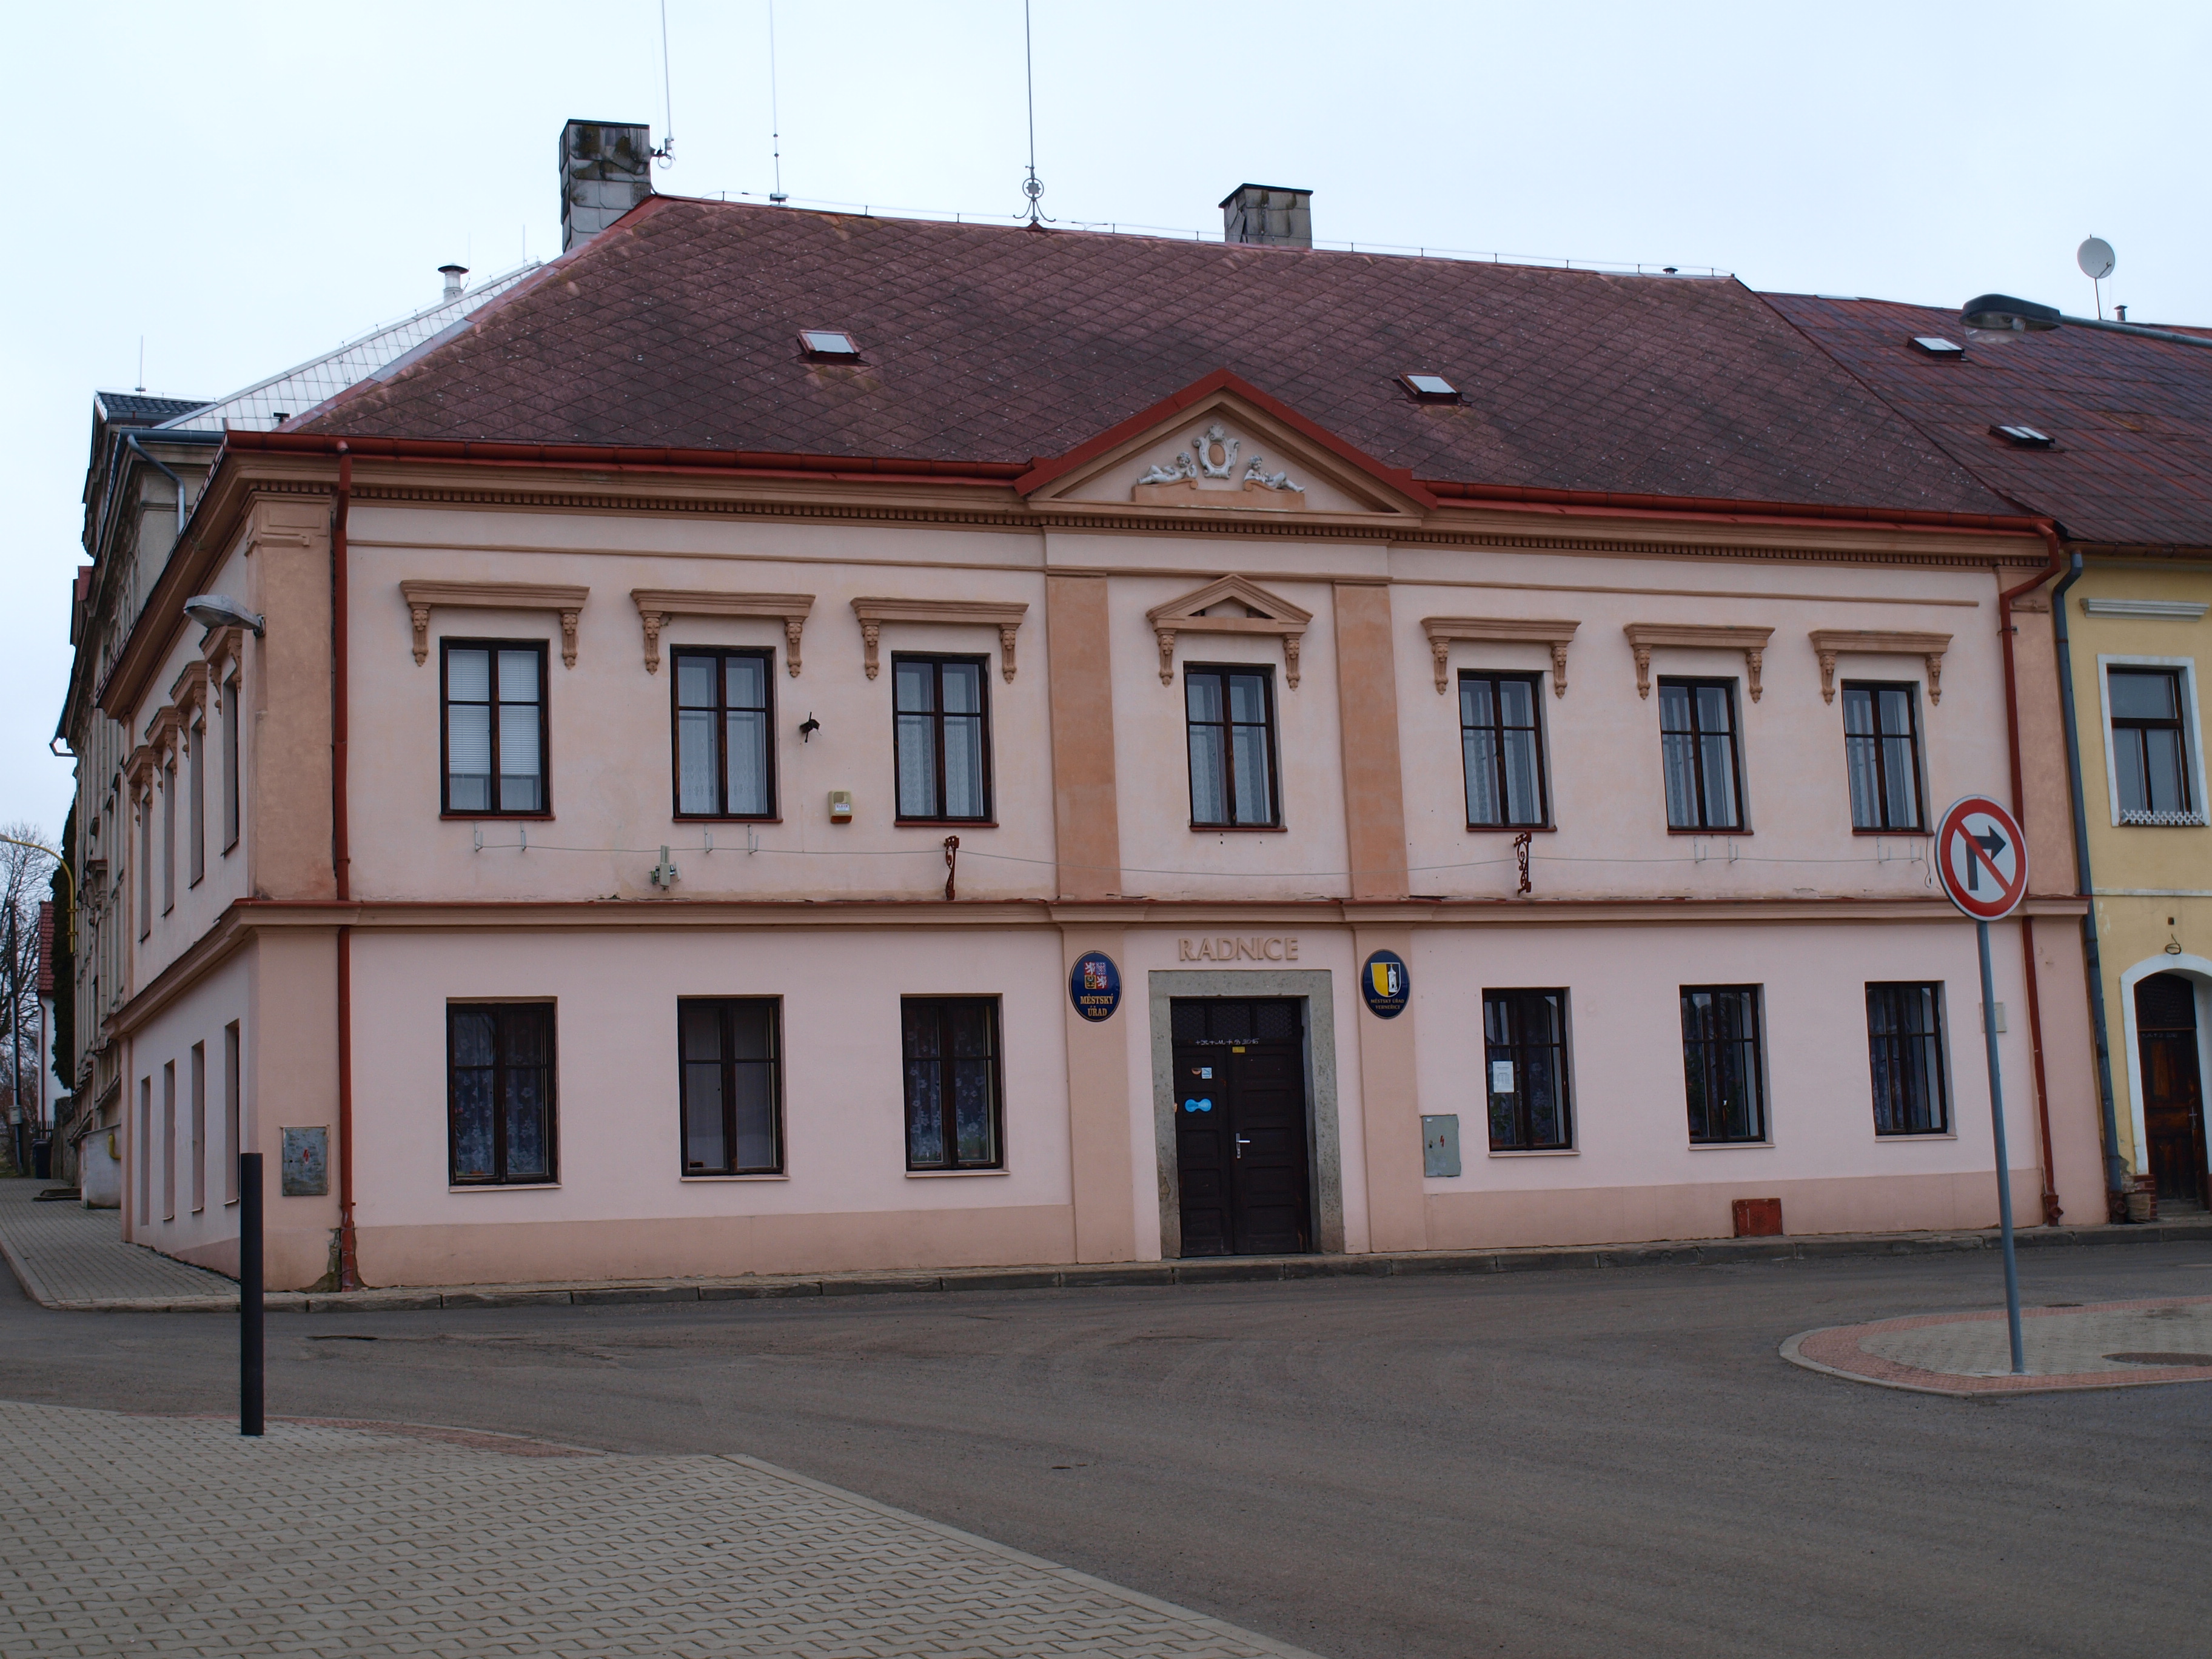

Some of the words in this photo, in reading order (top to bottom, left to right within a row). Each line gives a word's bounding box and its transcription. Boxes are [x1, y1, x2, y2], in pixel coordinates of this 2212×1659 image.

[1179, 937, 1298, 961] RADNICE
[1080, 993, 1114, 1004] MĚSTSKÝ
[1088, 1005, 1107, 1016] ÚŘAD
